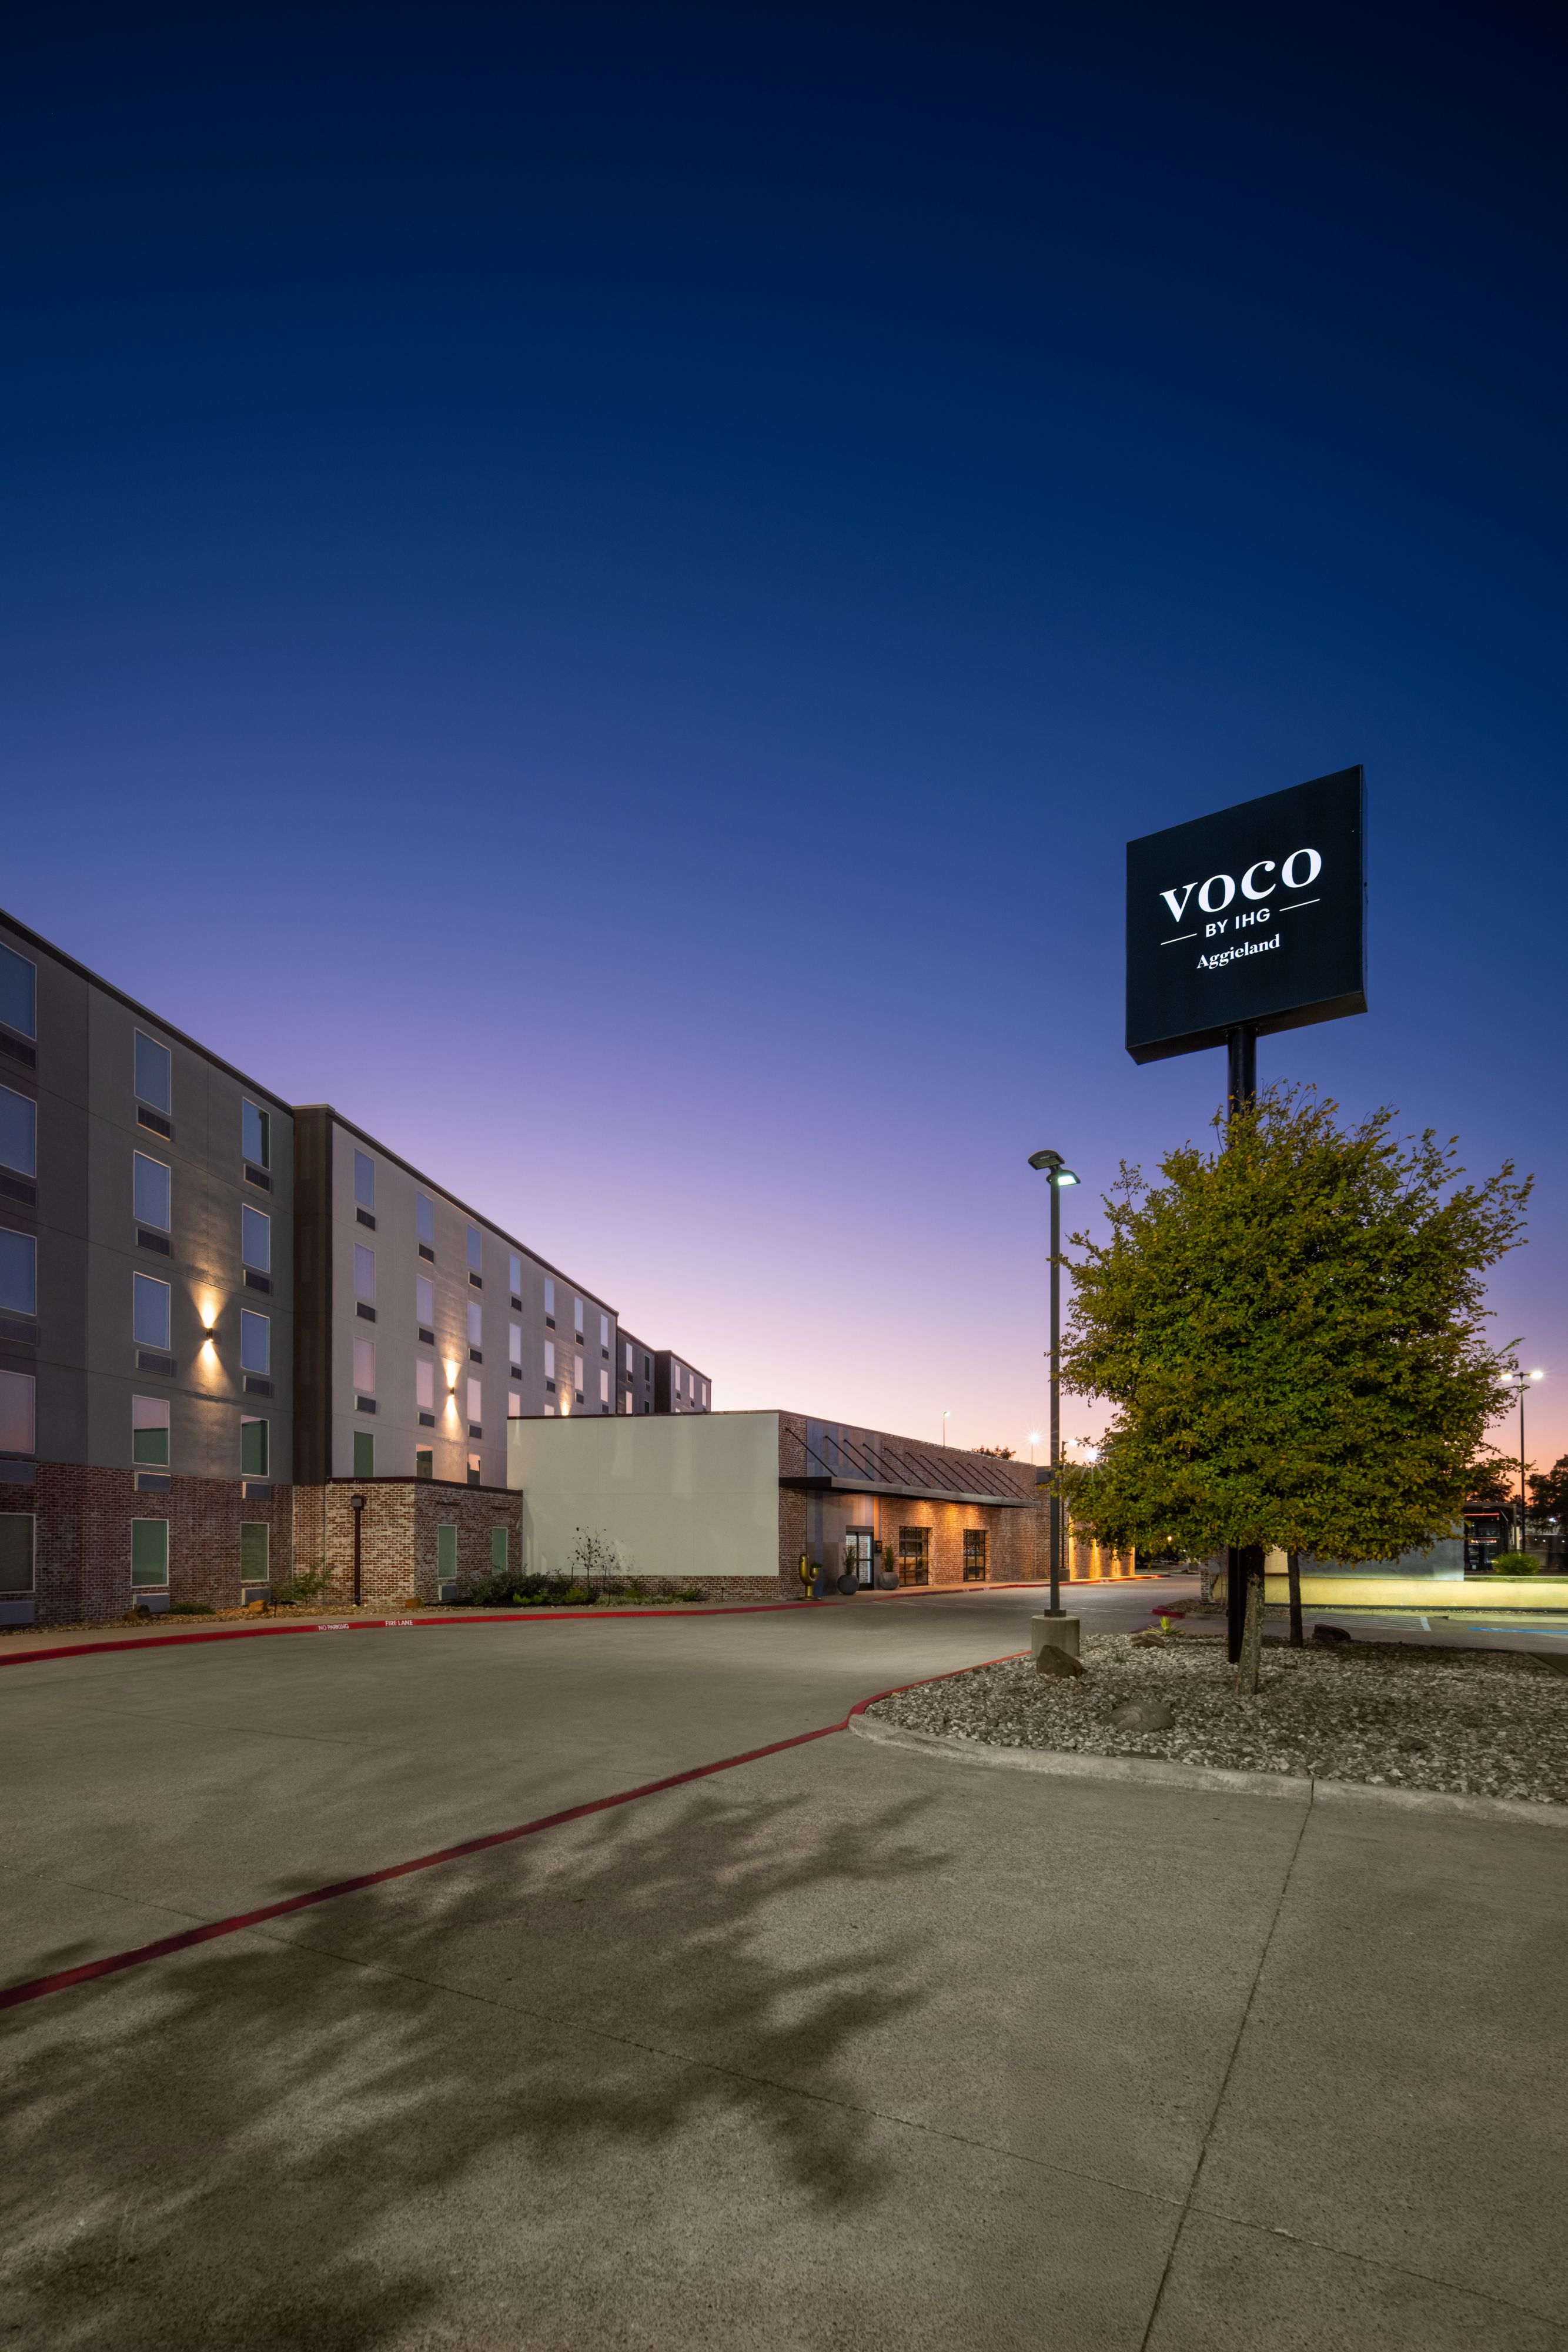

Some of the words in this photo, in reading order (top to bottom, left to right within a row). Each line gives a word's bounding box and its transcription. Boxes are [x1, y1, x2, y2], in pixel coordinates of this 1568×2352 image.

[1206, 919, 1228, 937] BY
[1235, 908, 1271, 929] IHG
[1196, 934, 1281, 969] Aggieland
